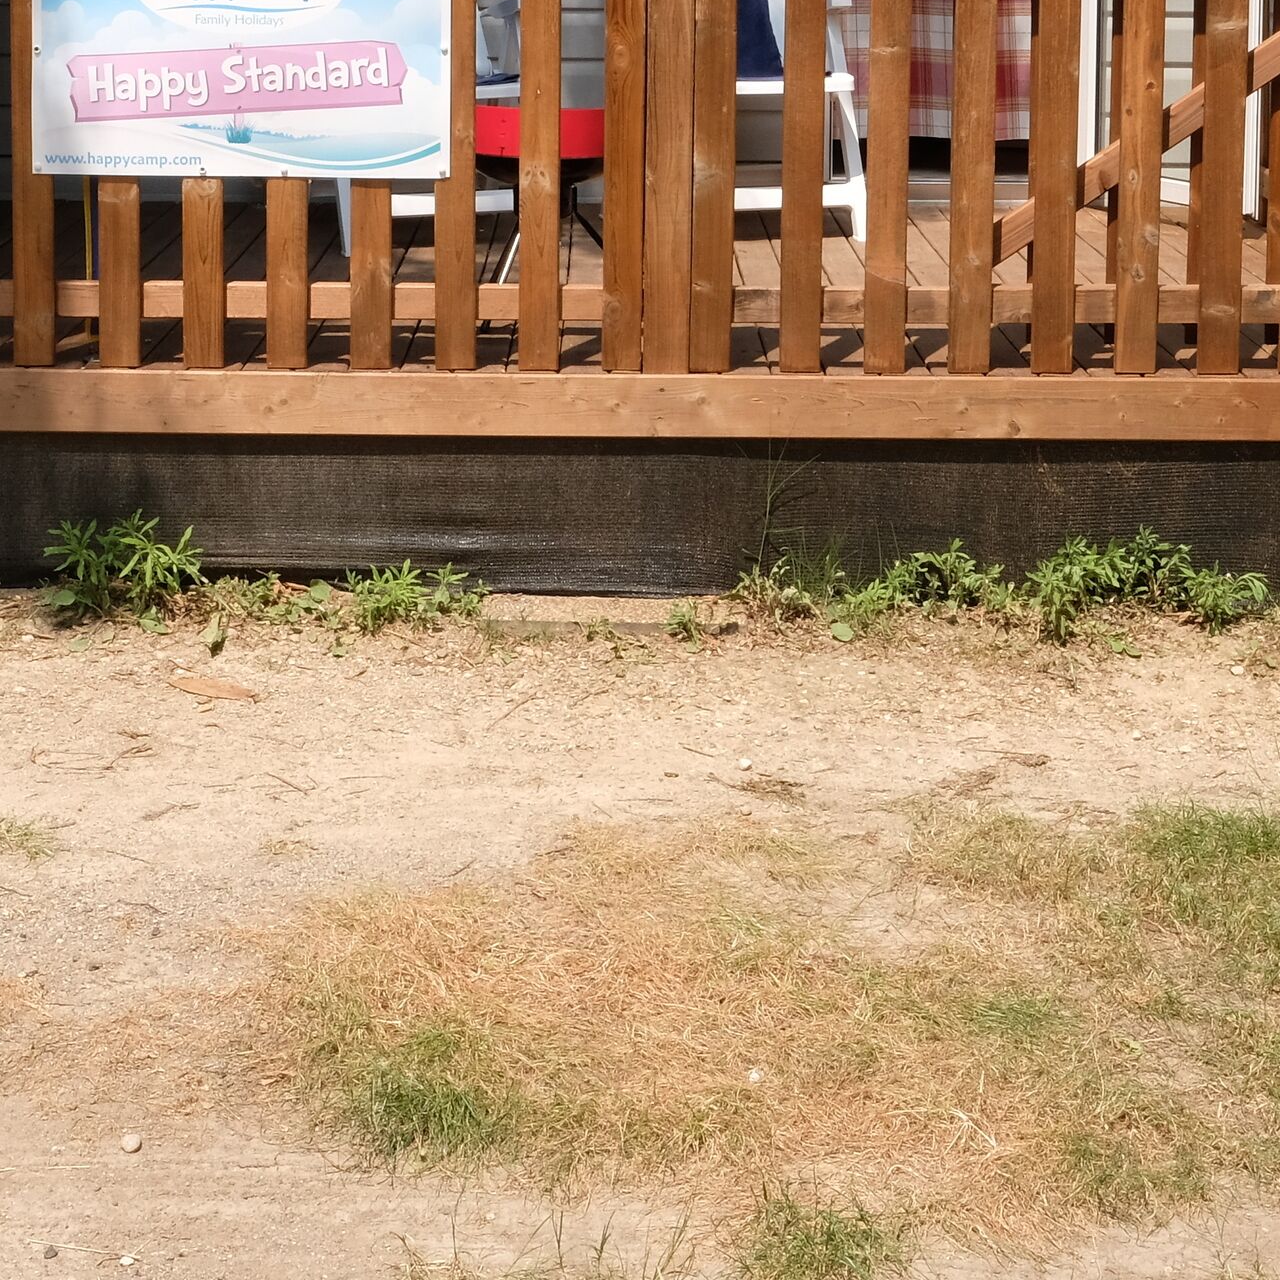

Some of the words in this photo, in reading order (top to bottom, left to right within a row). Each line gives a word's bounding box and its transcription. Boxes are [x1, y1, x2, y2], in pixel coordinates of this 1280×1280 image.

[195, 13, 232, 27] Family
[234, 13, 285, 27] Holidays
[87, 62, 209, 113] Happy
[222, 47, 391, 94] Standard
[45, 152, 203, 168] www.happycamp.com
